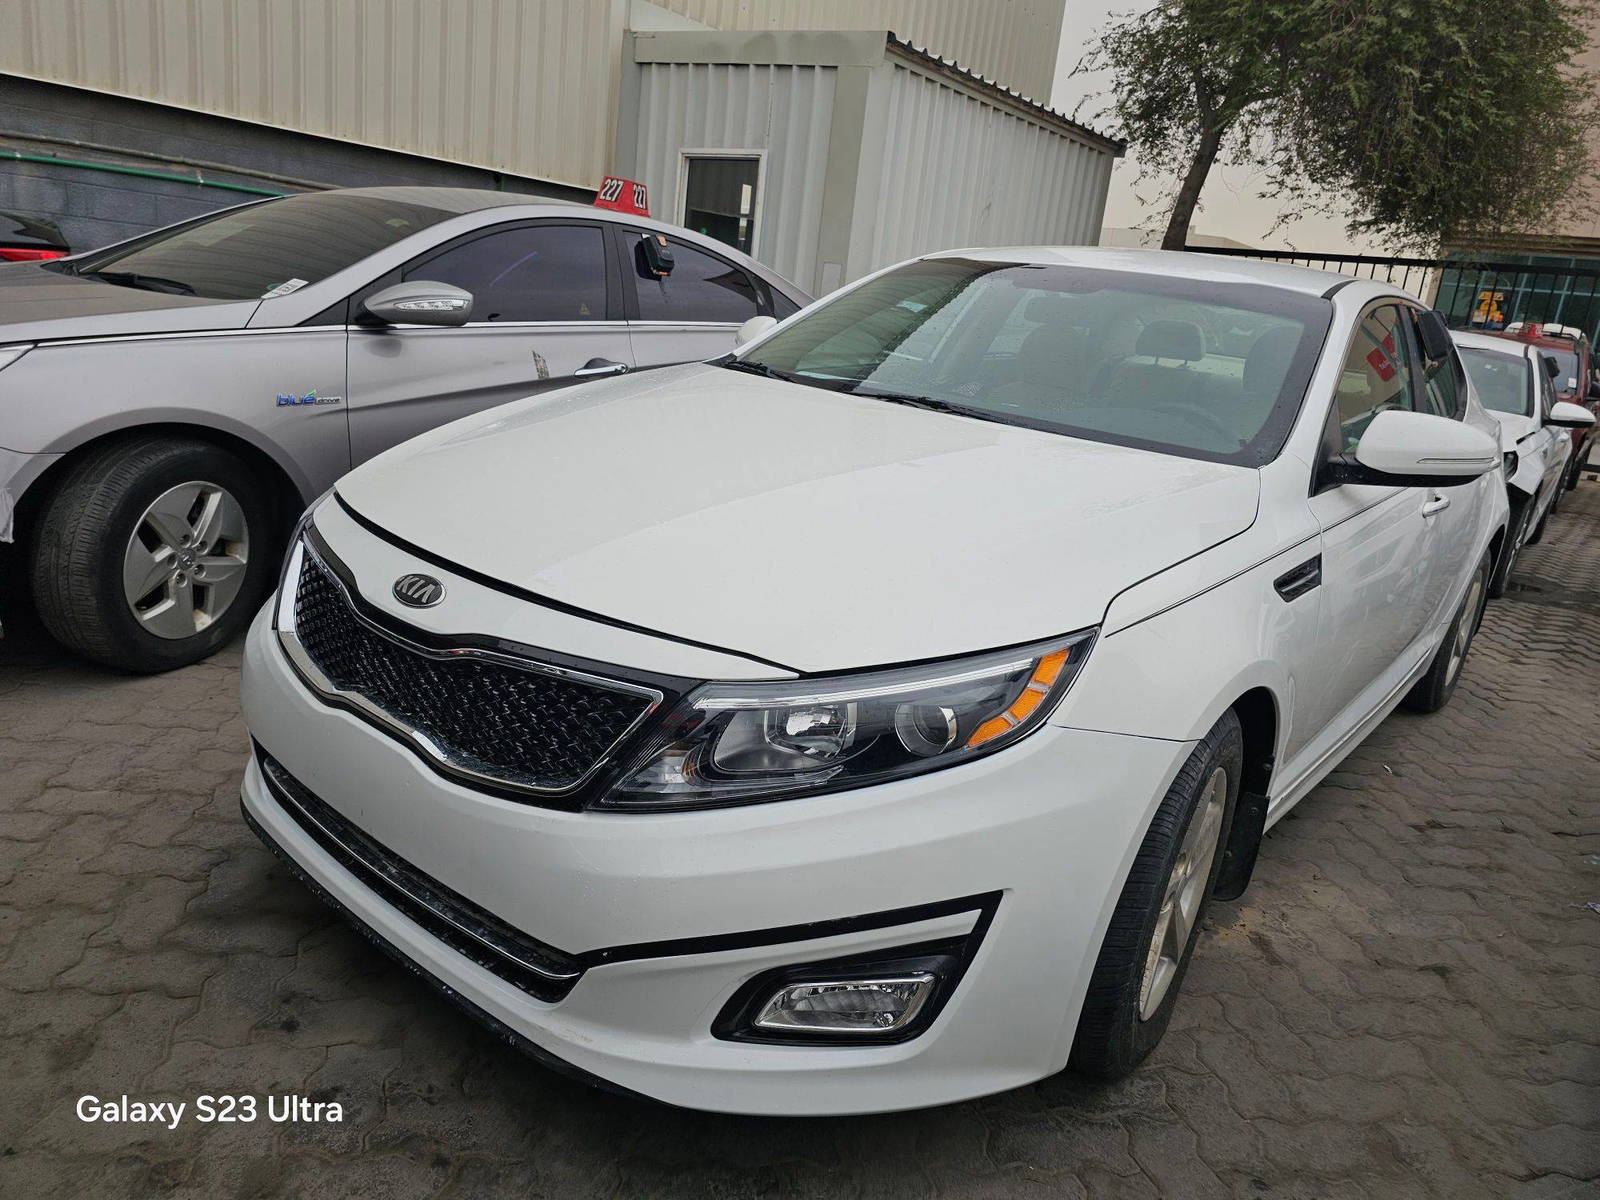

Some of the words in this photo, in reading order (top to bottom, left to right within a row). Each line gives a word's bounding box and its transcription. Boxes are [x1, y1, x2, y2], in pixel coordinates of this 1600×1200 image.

[599, 178, 625, 202] 227
[633, 183, 646, 210] 227
[276, 391, 317, 407] blue
[396, 575, 436, 604] KIA
